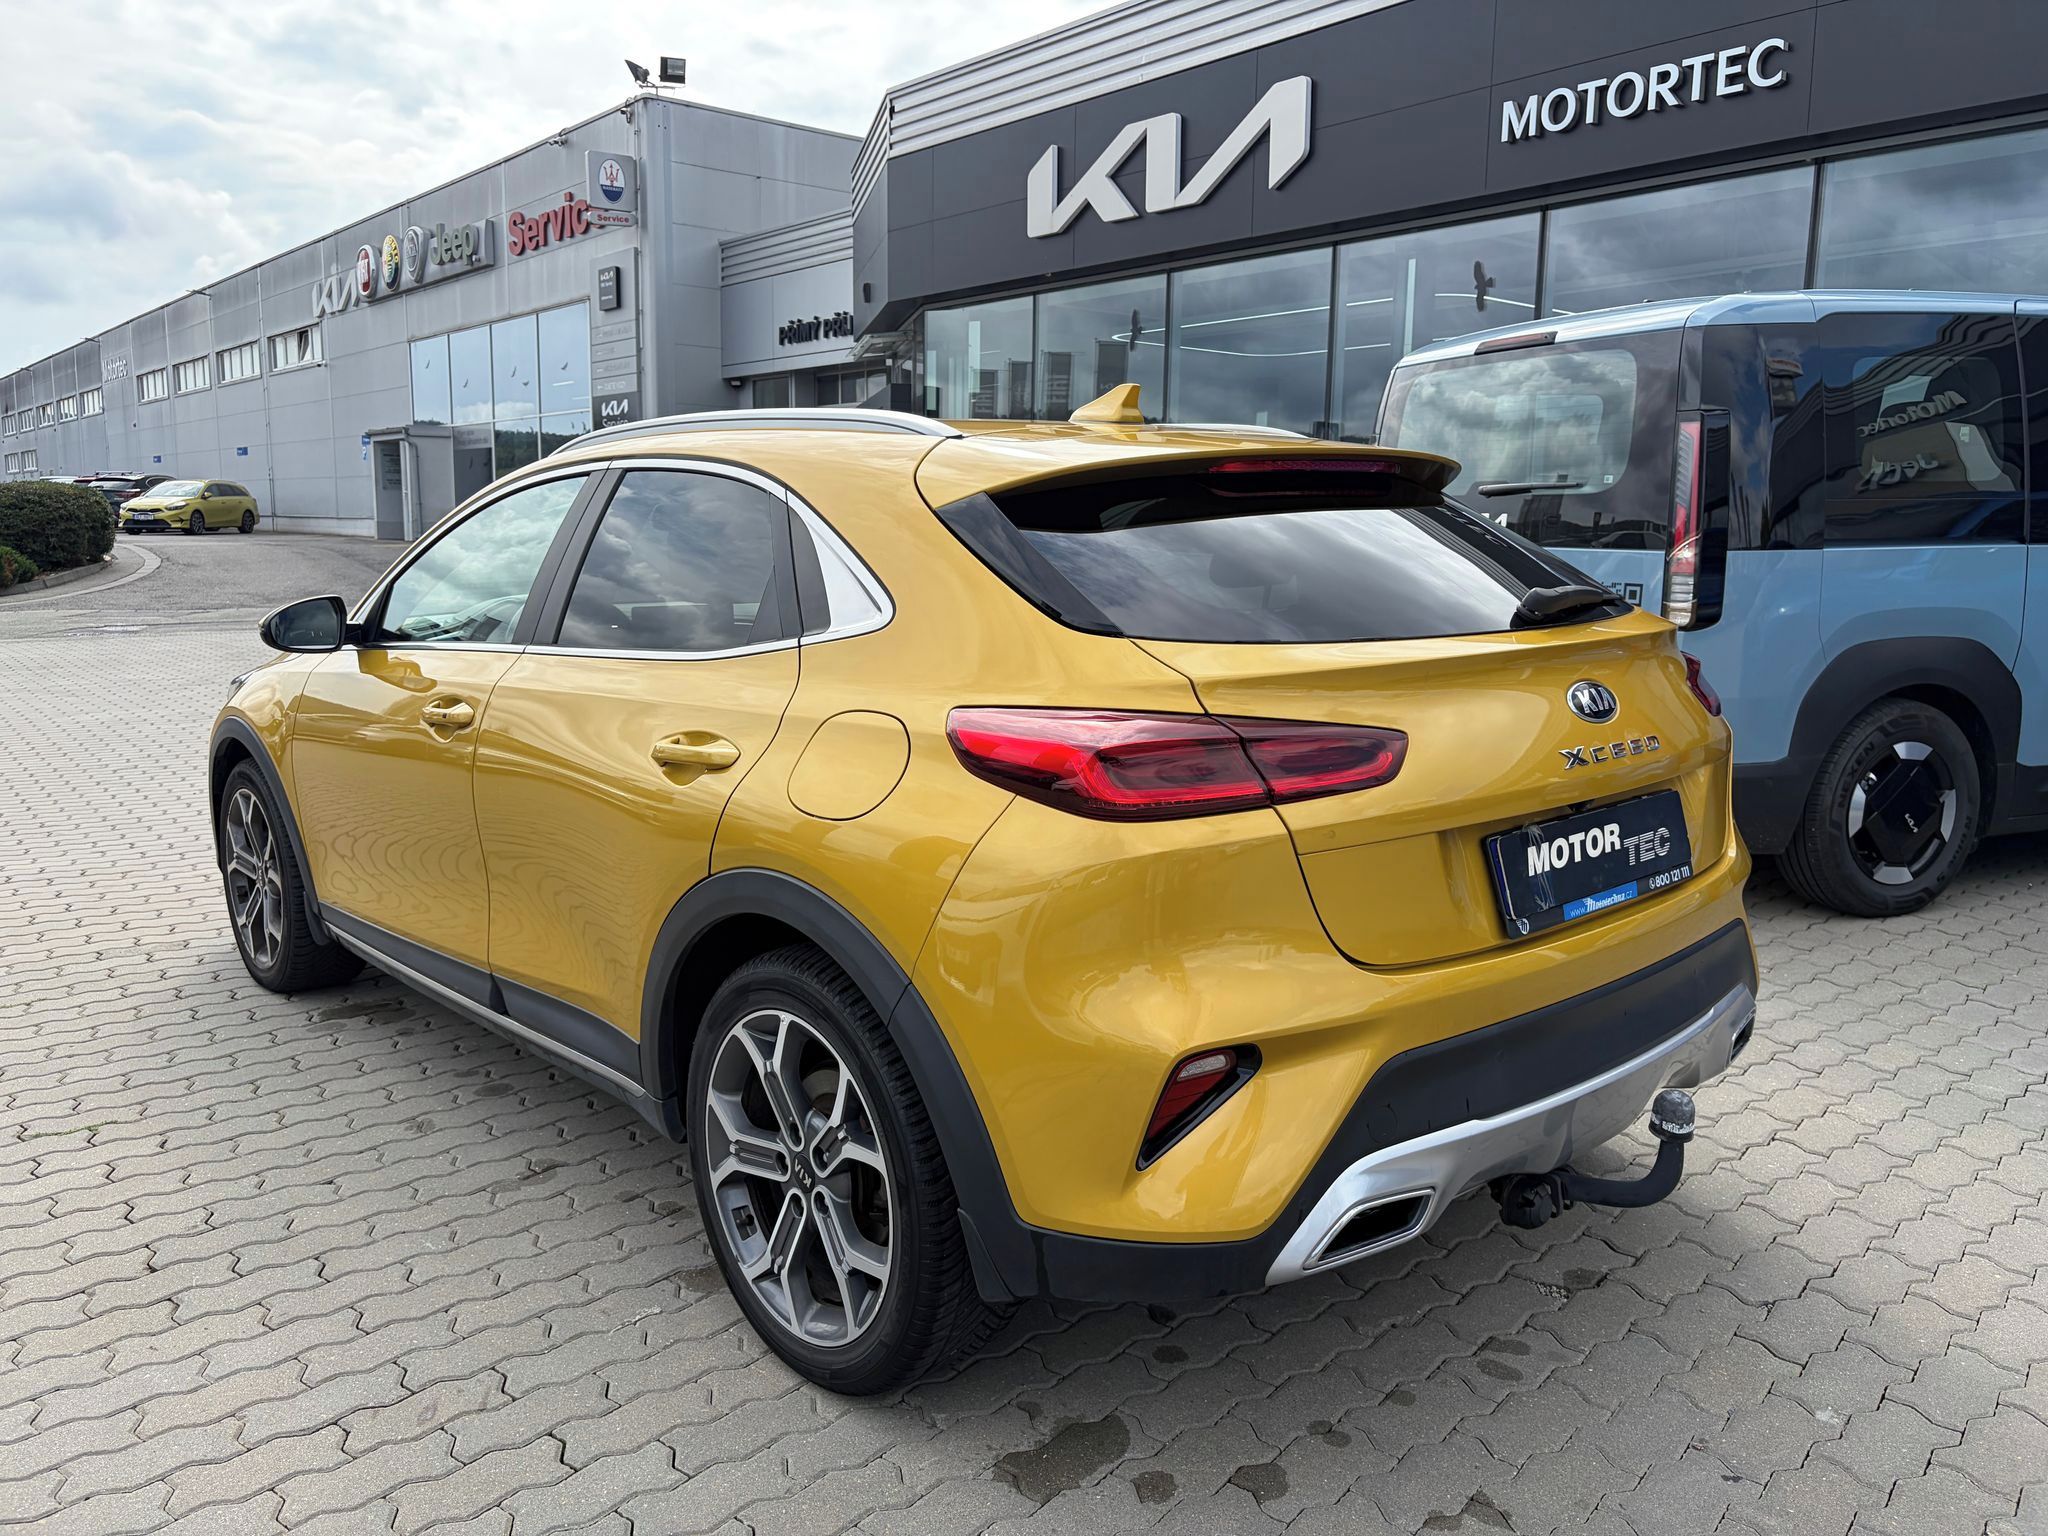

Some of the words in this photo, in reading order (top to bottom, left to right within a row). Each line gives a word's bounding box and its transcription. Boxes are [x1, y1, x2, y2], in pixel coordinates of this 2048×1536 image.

[1501, 37, 1789, 143] MOTORTEC
[1027, 75, 1312, 239] KIA
[508, 191, 606, 256] Servic
[597, 213, 630, 223] Service
[431, 222, 476, 266] Jeep
[312, 270, 361, 318] KIA
[602, 399, 628, 417] KIA
[1574, 686, 1617, 714] KIA
[1558, 735, 1660, 770] XCEED
[1527, 823, 1622, 877] MOTOR
[1623, 827, 1670, 866] TEC
[1655, 872, 1671, 888] 800
[1670, 868, 1682, 882] 121
[1681, 865, 1691, 879] 111
[794, 1158, 812, 1189] KIA
